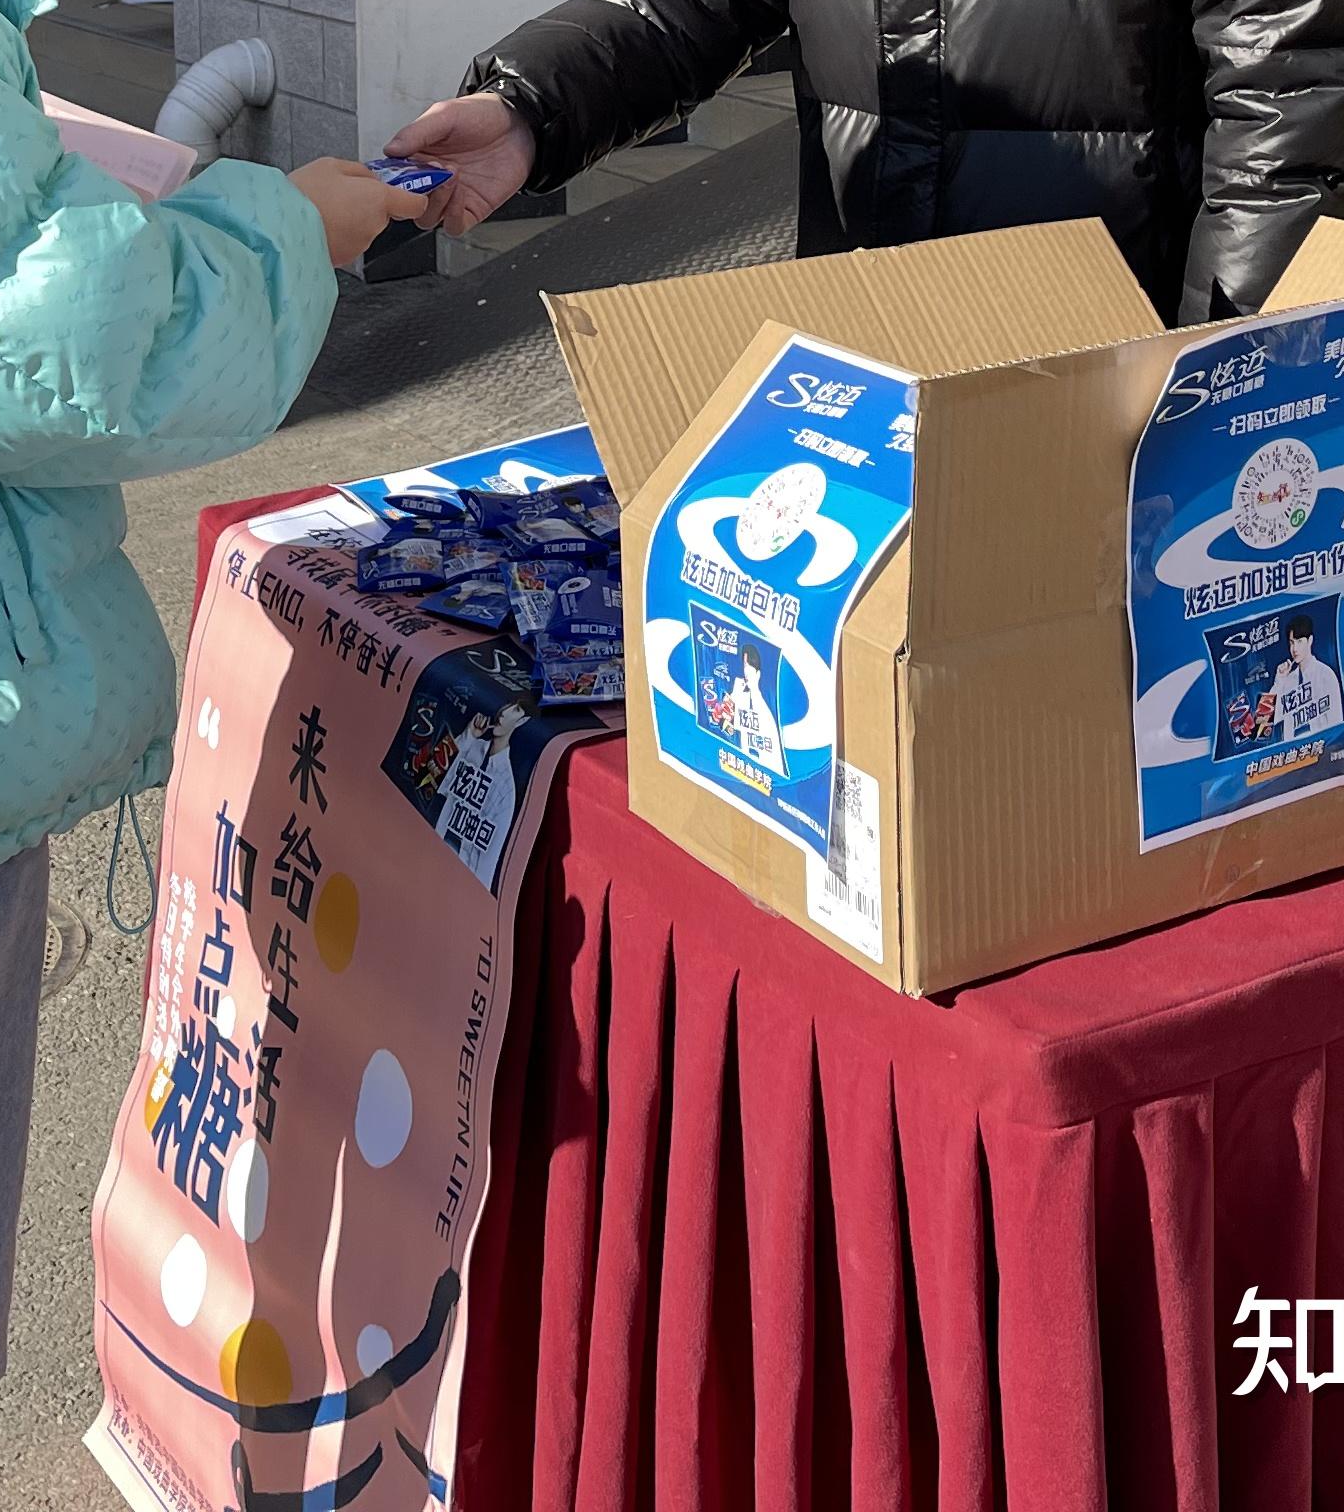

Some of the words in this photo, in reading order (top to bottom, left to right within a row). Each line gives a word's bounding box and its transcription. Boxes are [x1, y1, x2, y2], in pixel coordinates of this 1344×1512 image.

[1210, 345, 1269, 390] 炫迈
[1229, 393, 1327, 436] 扫码立即领取
[682, 550, 800, 633] 炫迈加油包1份
[1249, 616, 1280, 643] 炫迈
[738, 709, 760, 732] 炫迈
[1281, 681, 1312, 715] 炫迈
[1293, 694, 1331, 729] 加油包
[1245, 739, 1326, 778] 中国戏曲学院
[449, 760, 493, 812] 炫迈
[448, 800, 496, 853] 加油包
[243, 703, 328, 1145] 来给生活
[476, 934, 493, 984] TO
[152, 799, 258, 1229] 加点糖
[456, 988, 487, 1149] SWEETN
[435, 1152, 468, 1242] LIFE
